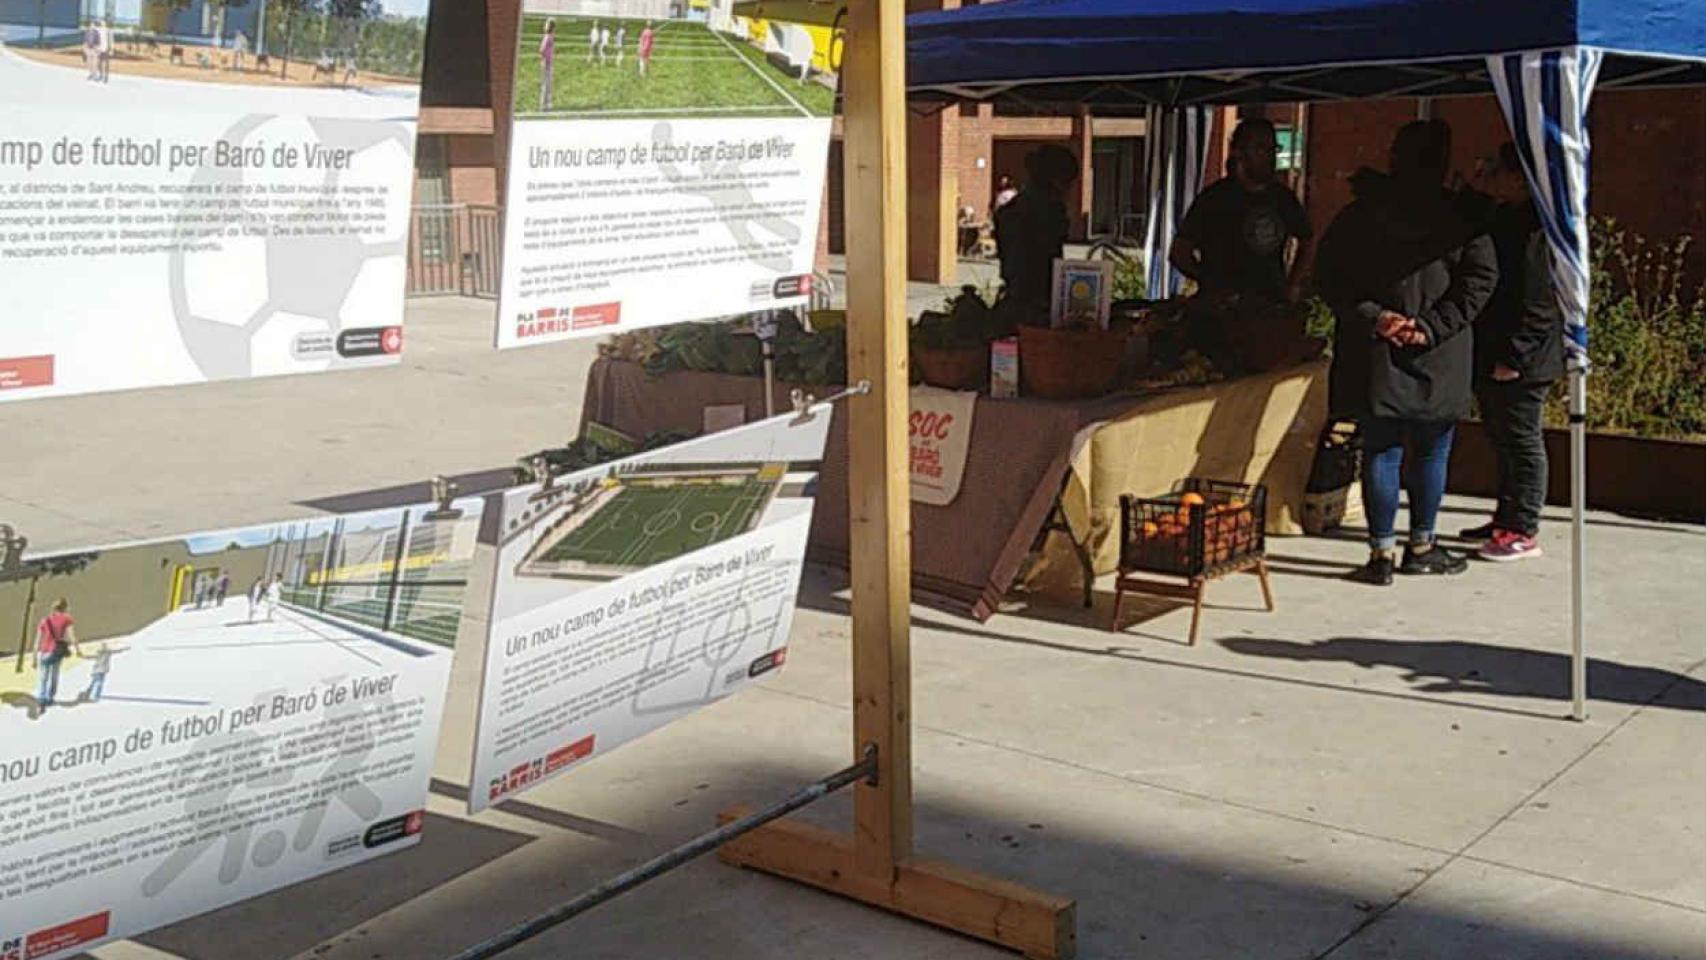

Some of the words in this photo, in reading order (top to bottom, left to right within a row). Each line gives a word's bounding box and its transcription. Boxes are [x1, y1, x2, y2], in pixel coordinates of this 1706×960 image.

[52, 136, 83, 166] de
[92, 136, 162, 167] futbol
[169, 144, 208, 173] per
[215, 139, 266, 168] Baró
[272, 142, 298, 169] de
[303, 142, 356, 170] Viver
[529, 145, 550, 169] Un
[554, 148, 582, 168] nou
[586, 147, 626, 169] camp
[630, 142, 647, 165] de
[651, 140, 690, 164] futbol
[692, 145, 714, 166] per
[506, 635, 527, 657] Un
[530, 623, 561, 647] nou
[564, 607, 604, 636] camp
[607, 598, 627, 618] de
[0, 756, 40, 782] nou
[49, 737, 117, 772] camp
[124, 727, 154, 753] de
[160, 708, 224, 744] futbol
[228, 703, 266, 734] per
[270, 685, 318, 720] Baró
[323, 682, 347, 707] de
[351, 672, 399, 700] Viver
